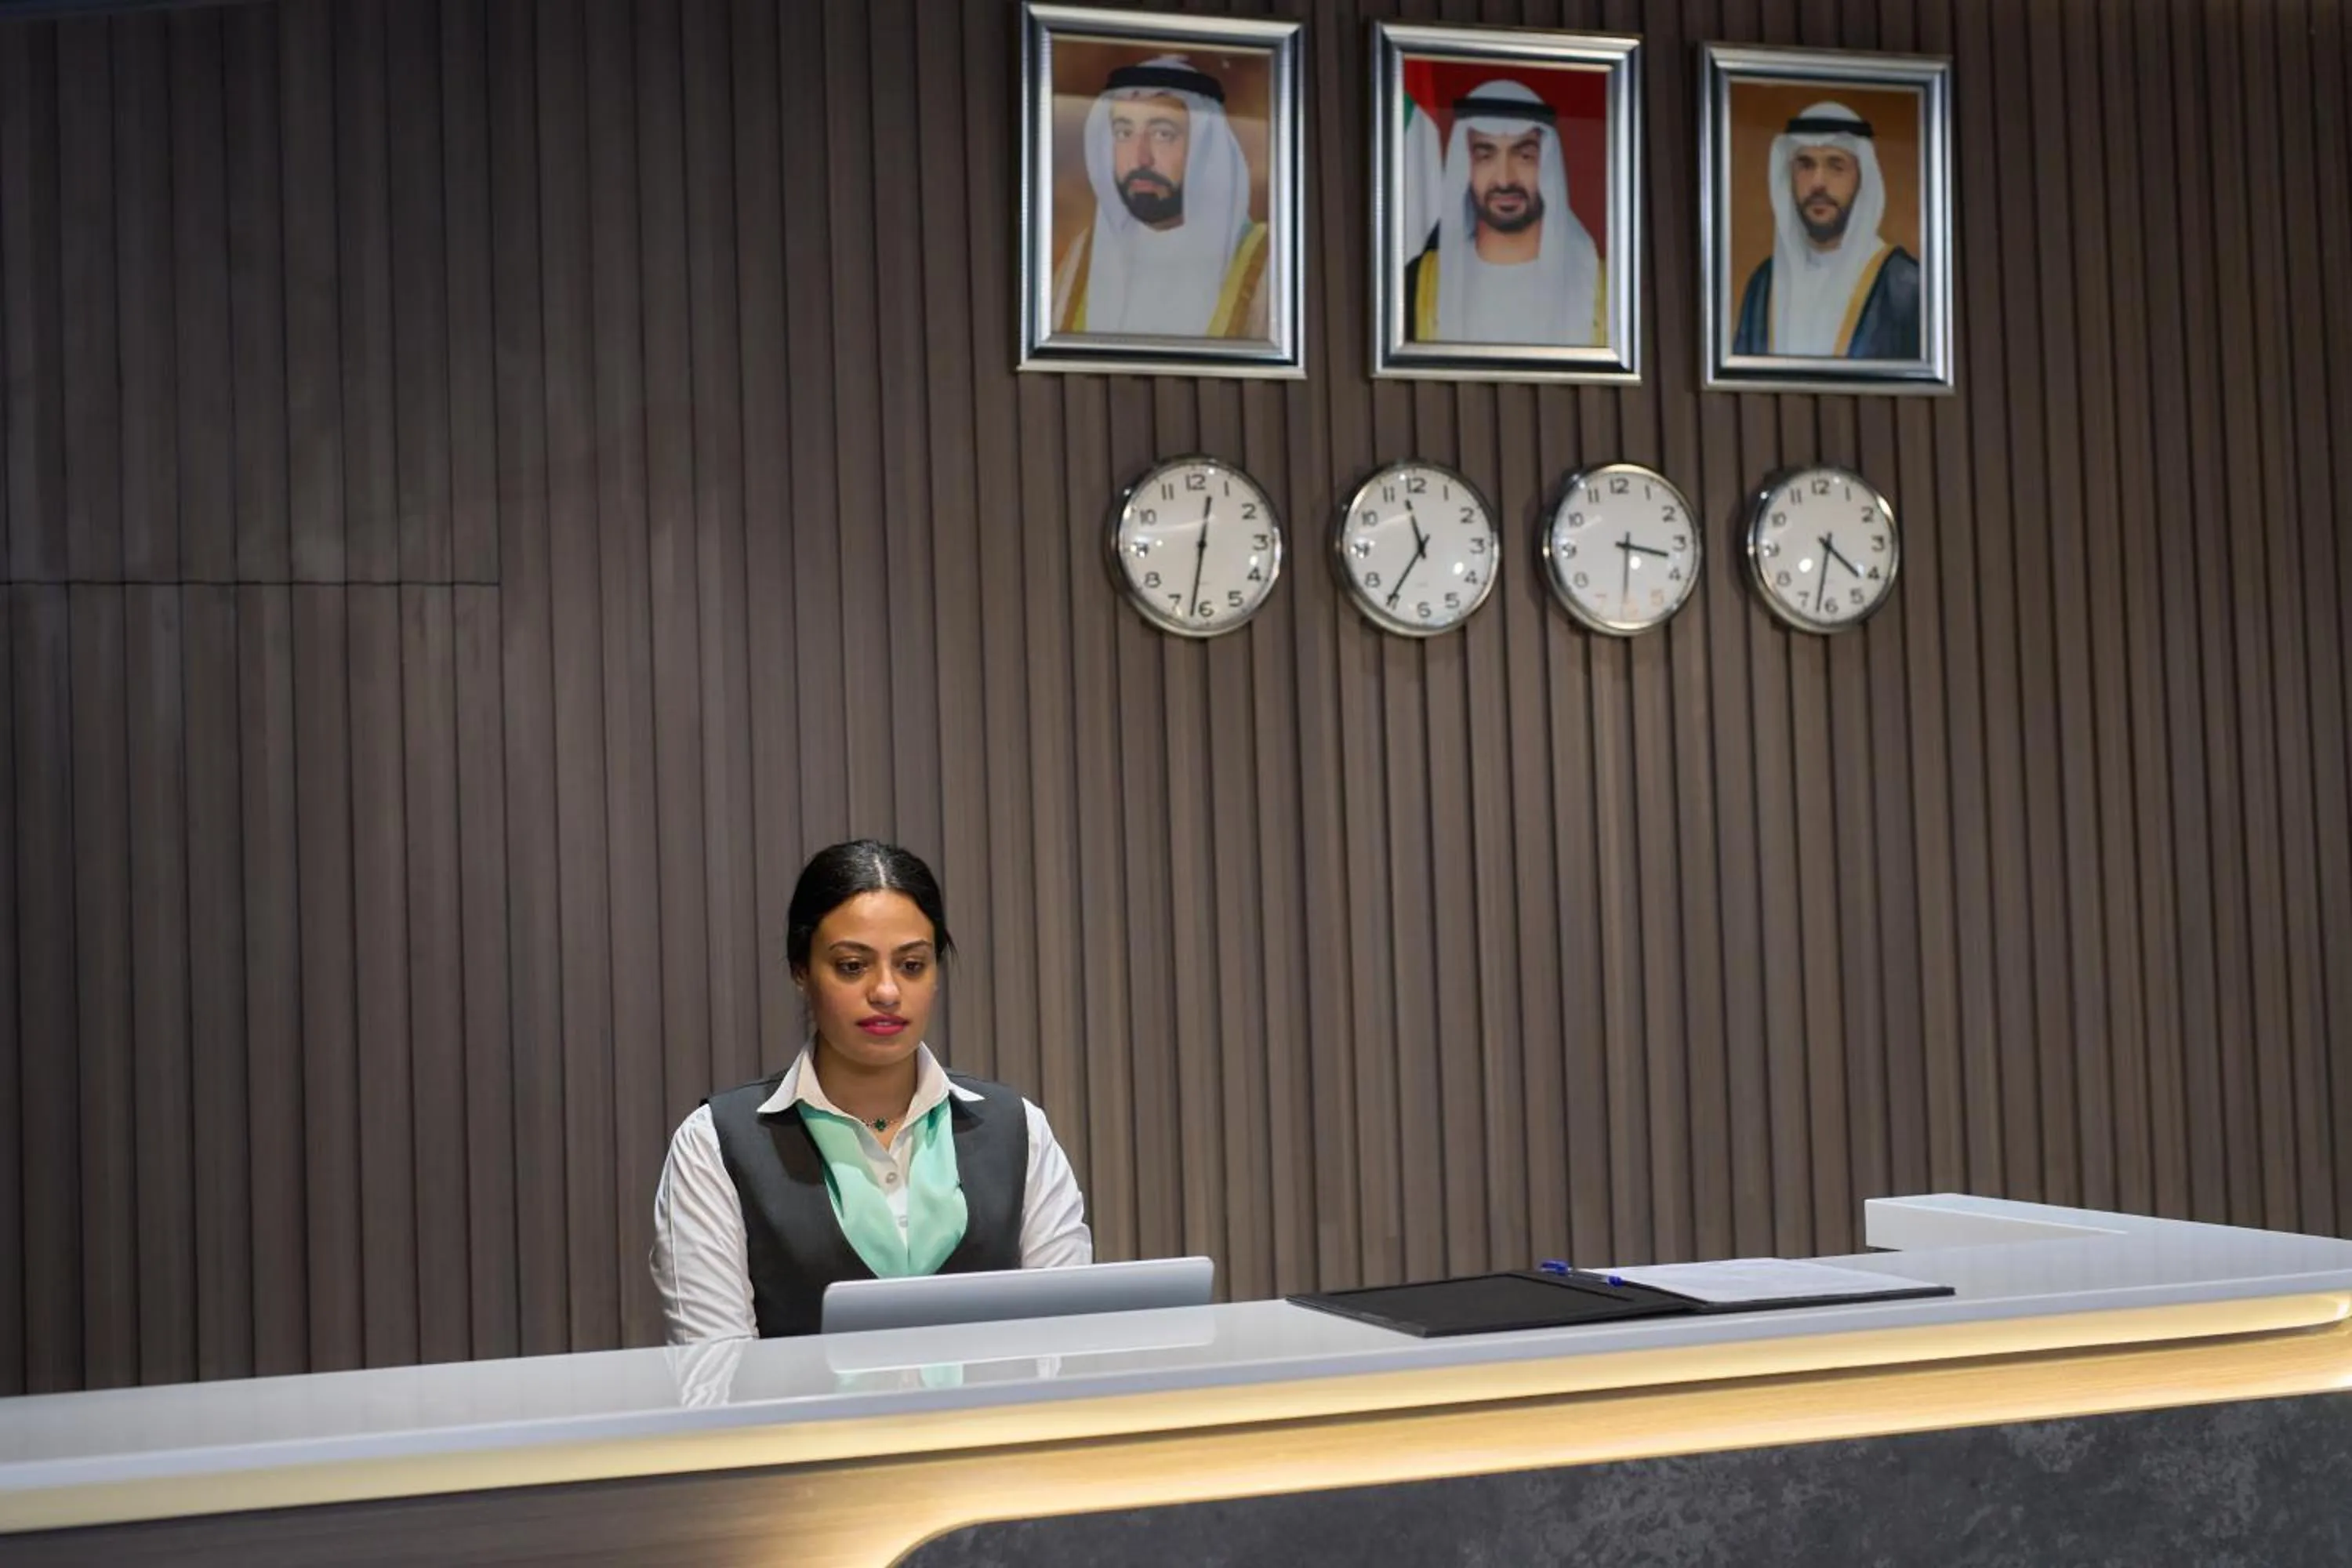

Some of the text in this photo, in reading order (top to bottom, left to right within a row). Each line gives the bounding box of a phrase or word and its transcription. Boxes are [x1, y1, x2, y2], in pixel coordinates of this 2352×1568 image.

[1185, 474, 1206, 491] 12
[1224, 481, 1229, 497] 1
[1406, 477, 1427, 494] 12
[1610, 477, 1629, 495] 12
[1811, 479, 1829, 495] 12
[1161, 484, 1174, 500] 11
[1383, 486, 1396, 503] 11
[1443, 485, 1449, 501] 1
[1588, 488, 1599, 503] 11
[1645, 485, 1651, 500] 1
[1790, 488, 1802, 504] 11
[1845, 486, 1851, 501] 1
[1140, 509, 1156, 525] 10
[1242, 503, 1257, 519] 2
[1362, 510, 1377, 526] 10
[1460, 507, 1475, 524] 2
[1662, 506, 1676, 522] 2
[1861, 506, 1874, 523] 2
[1568, 512, 1584, 527] 10
[1254, 534, 1268, 550] 3
[1470, 538, 1485, 554] 3
[1673, 535, 1686, 552] 3
[1871, 535, 1884, 552] 3
[1144, 572, 1161, 588] 8
[1247, 567, 1261, 581] 4
[1364, 572, 1381, 588] 8
[1464, 570, 1478, 584] 4
[1668, 567, 1681, 581] 4
[1867, 566, 1879, 580] 4
[1167, 593, 1181, 612] 7
[1227, 590, 1243, 607] 5
[1445, 592, 1461, 609] 5
[1797, 591, 1809, 607] 7
[1850, 588, 1864, 604] 5
[1198, 601, 1214, 617] 6
[1417, 601, 1432, 618] 6
[1824, 597, 1838, 614] 6
